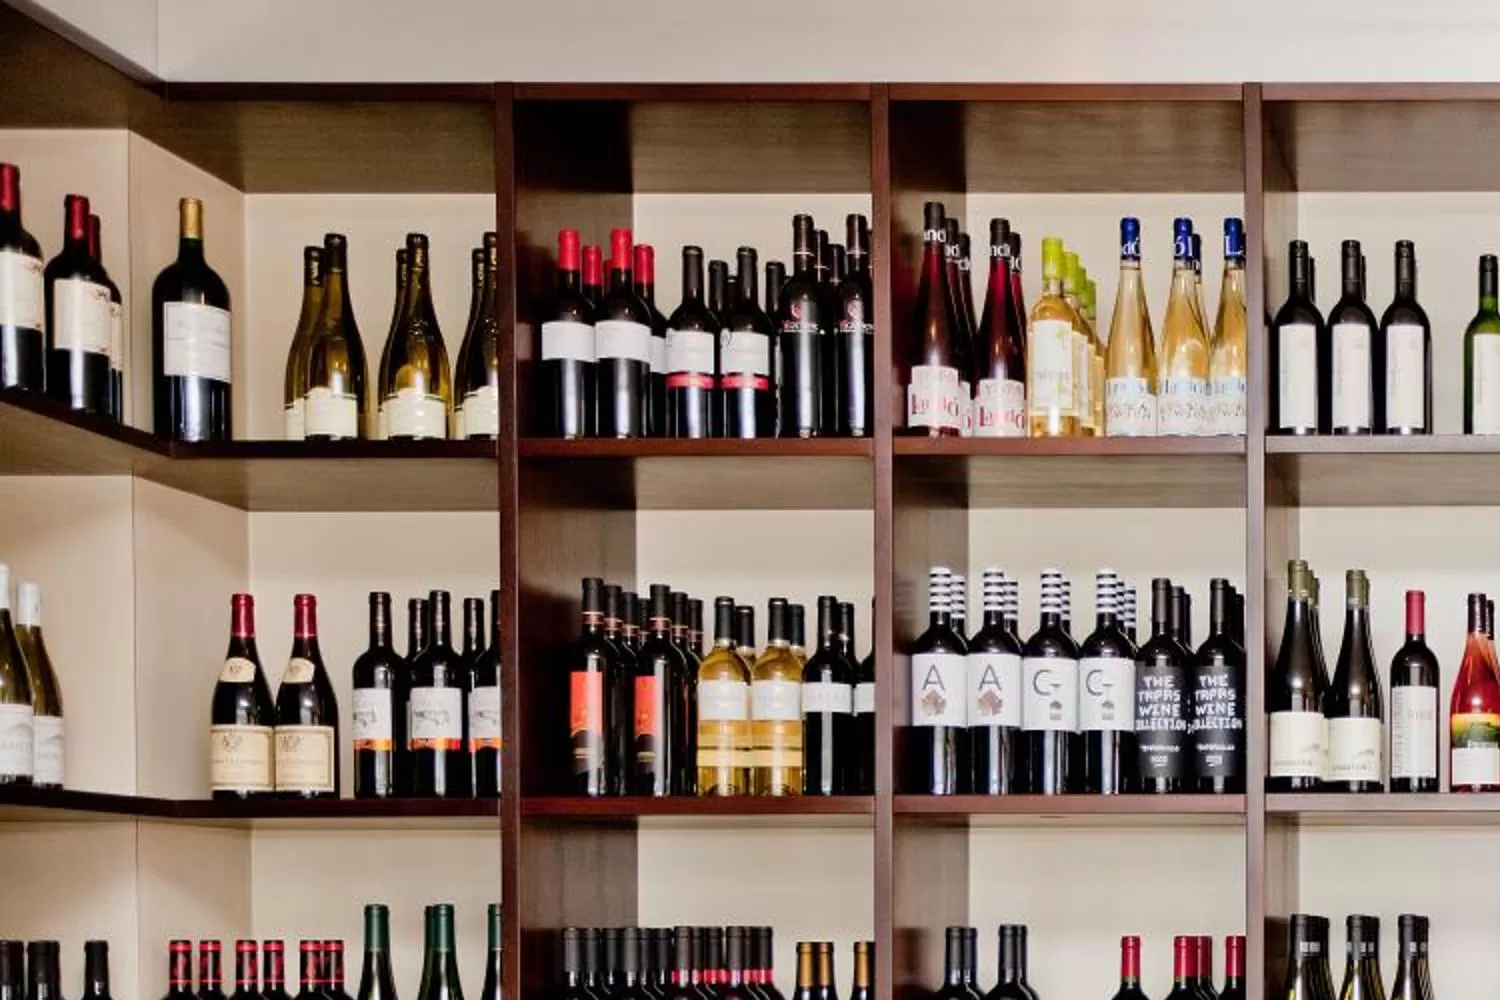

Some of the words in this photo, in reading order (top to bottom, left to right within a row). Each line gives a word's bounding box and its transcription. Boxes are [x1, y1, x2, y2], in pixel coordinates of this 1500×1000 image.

[1142, 675, 1175, 688] THE
[1199, 674, 1229, 688] THE
[1139, 703, 1181, 717] WINE
[1195, 702, 1236, 717] WINE
